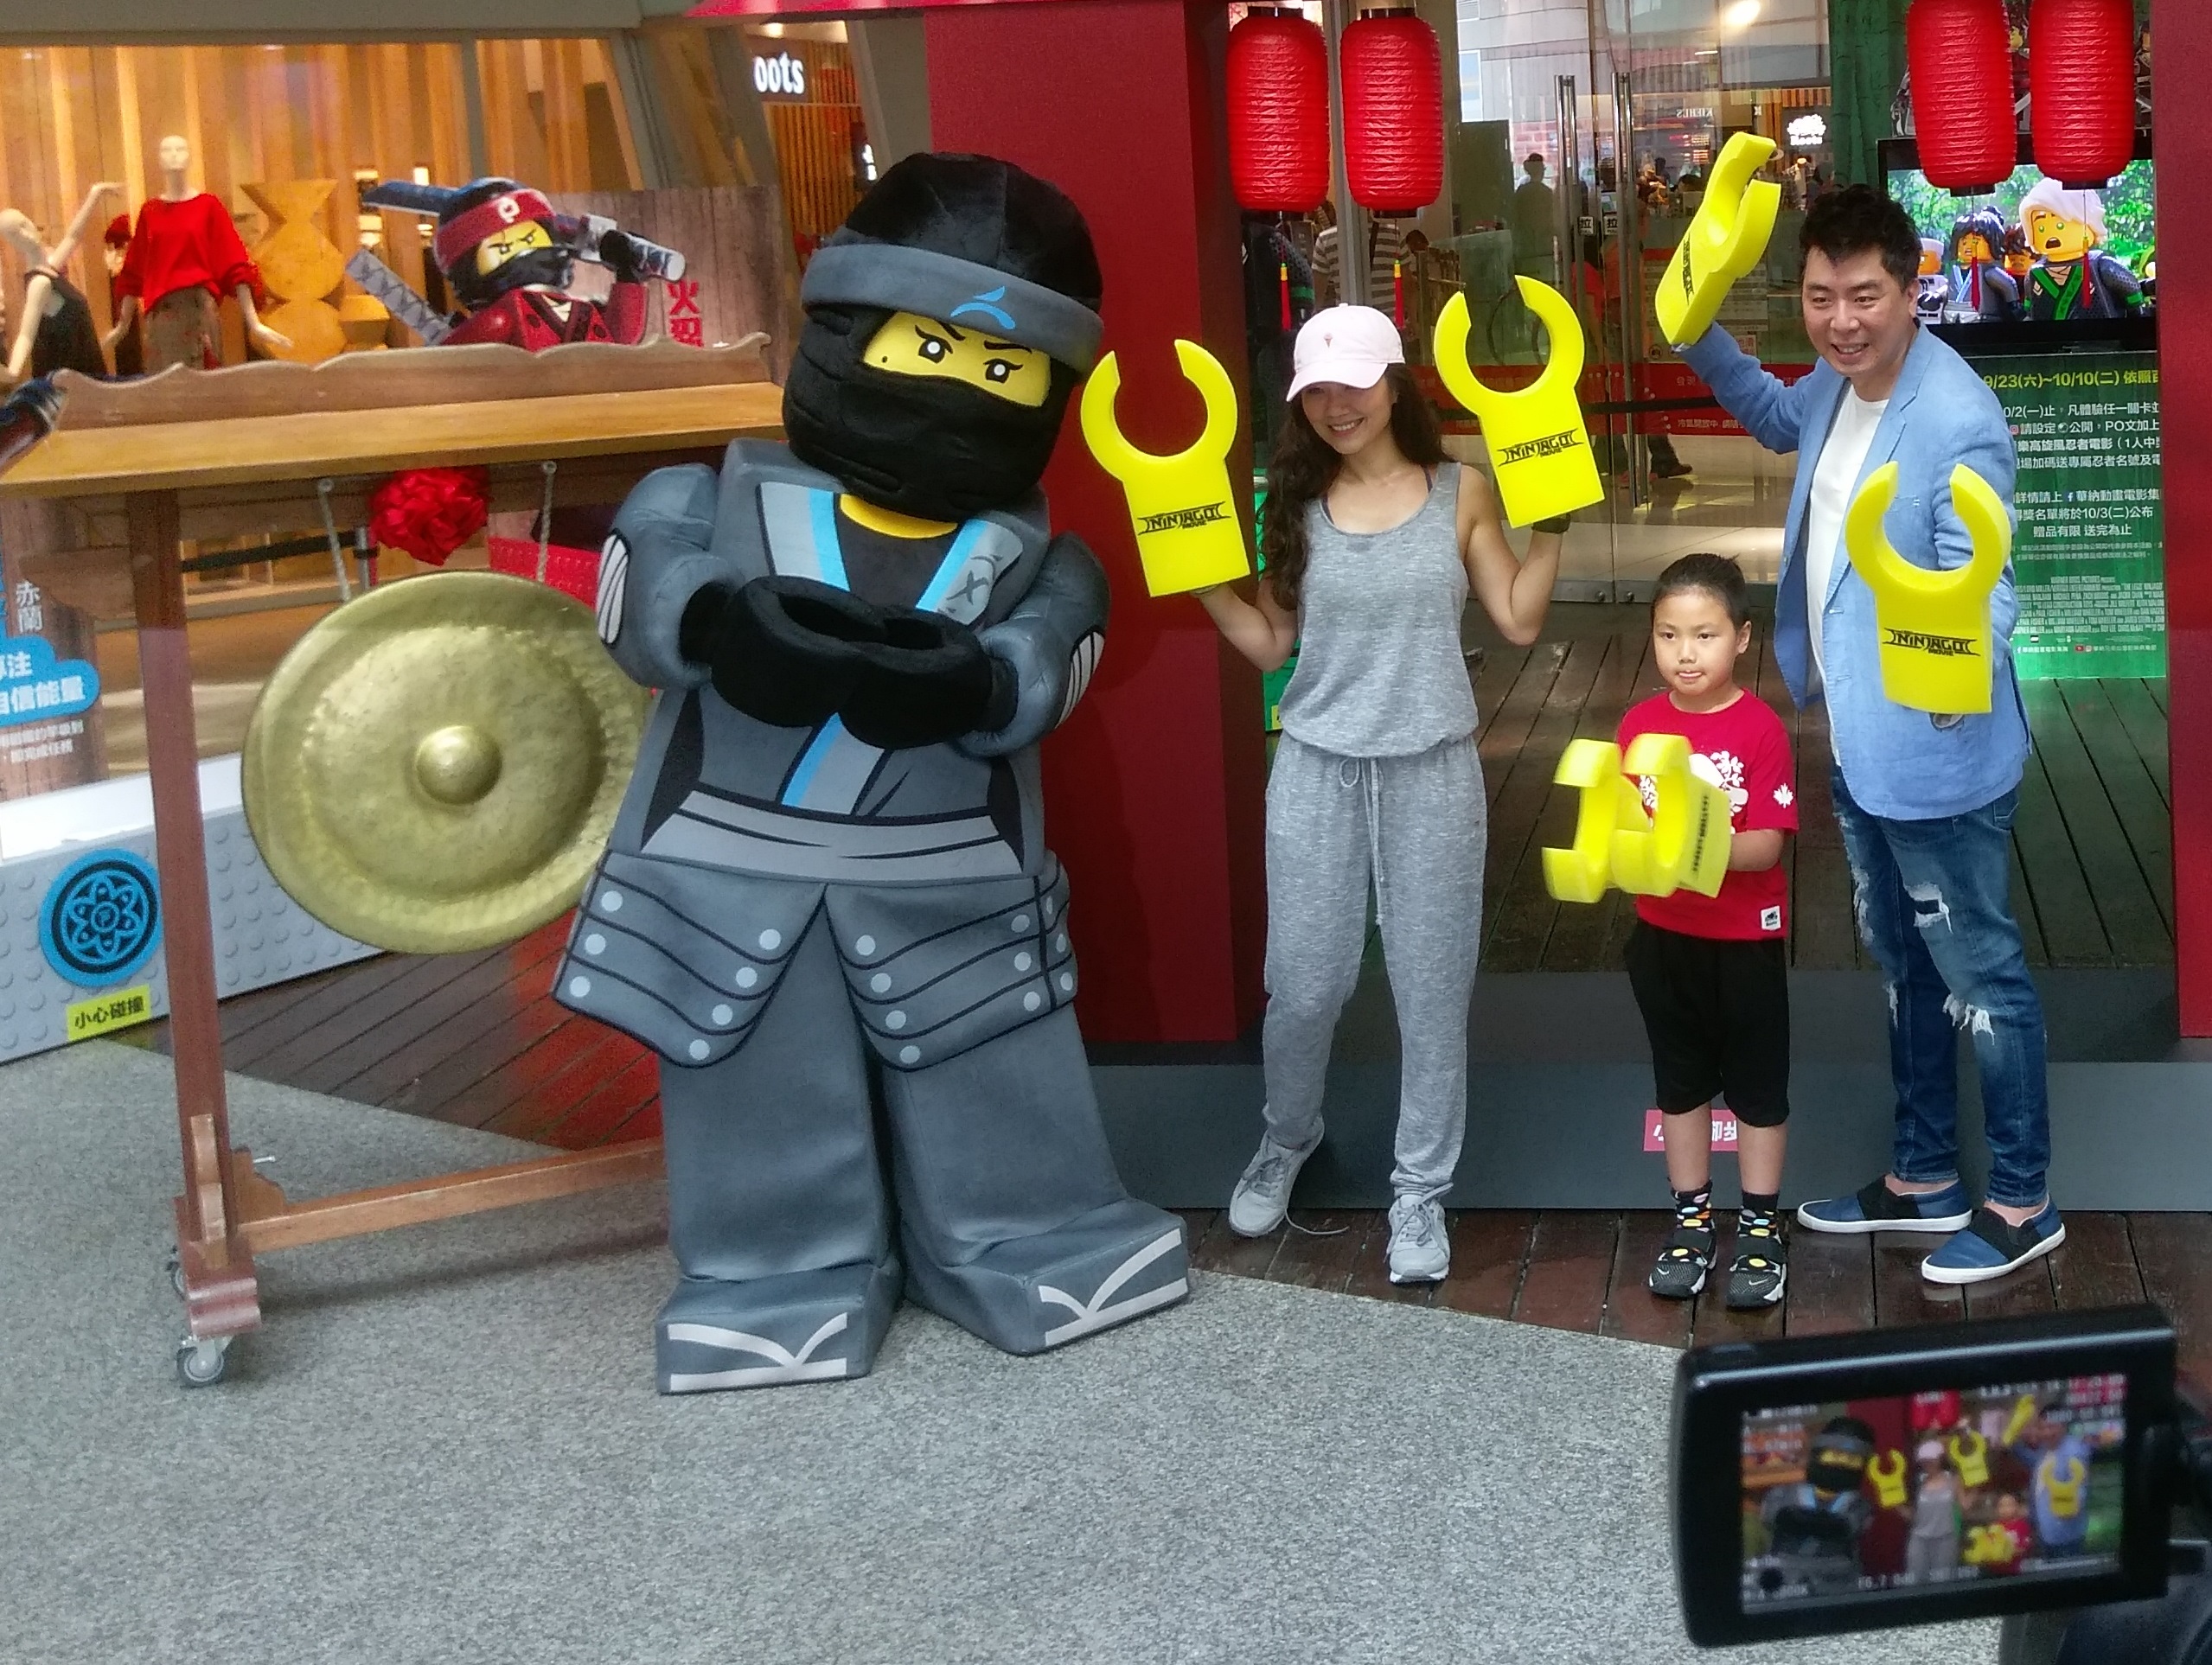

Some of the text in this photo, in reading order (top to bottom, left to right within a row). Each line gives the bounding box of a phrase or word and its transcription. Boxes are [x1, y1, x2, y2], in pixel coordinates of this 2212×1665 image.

[1506, 432, 1572, 462] NINJAGO
[2013, 490, 2063, 504] 詳情請上
[2076, 488, 2161, 502] 華納動畫電影集
[1146, 505, 1218, 533] NINJAGO
[1893, 631, 1967, 654] NINJAGO
[74, 995, 144, 1030] 小心碰撞
